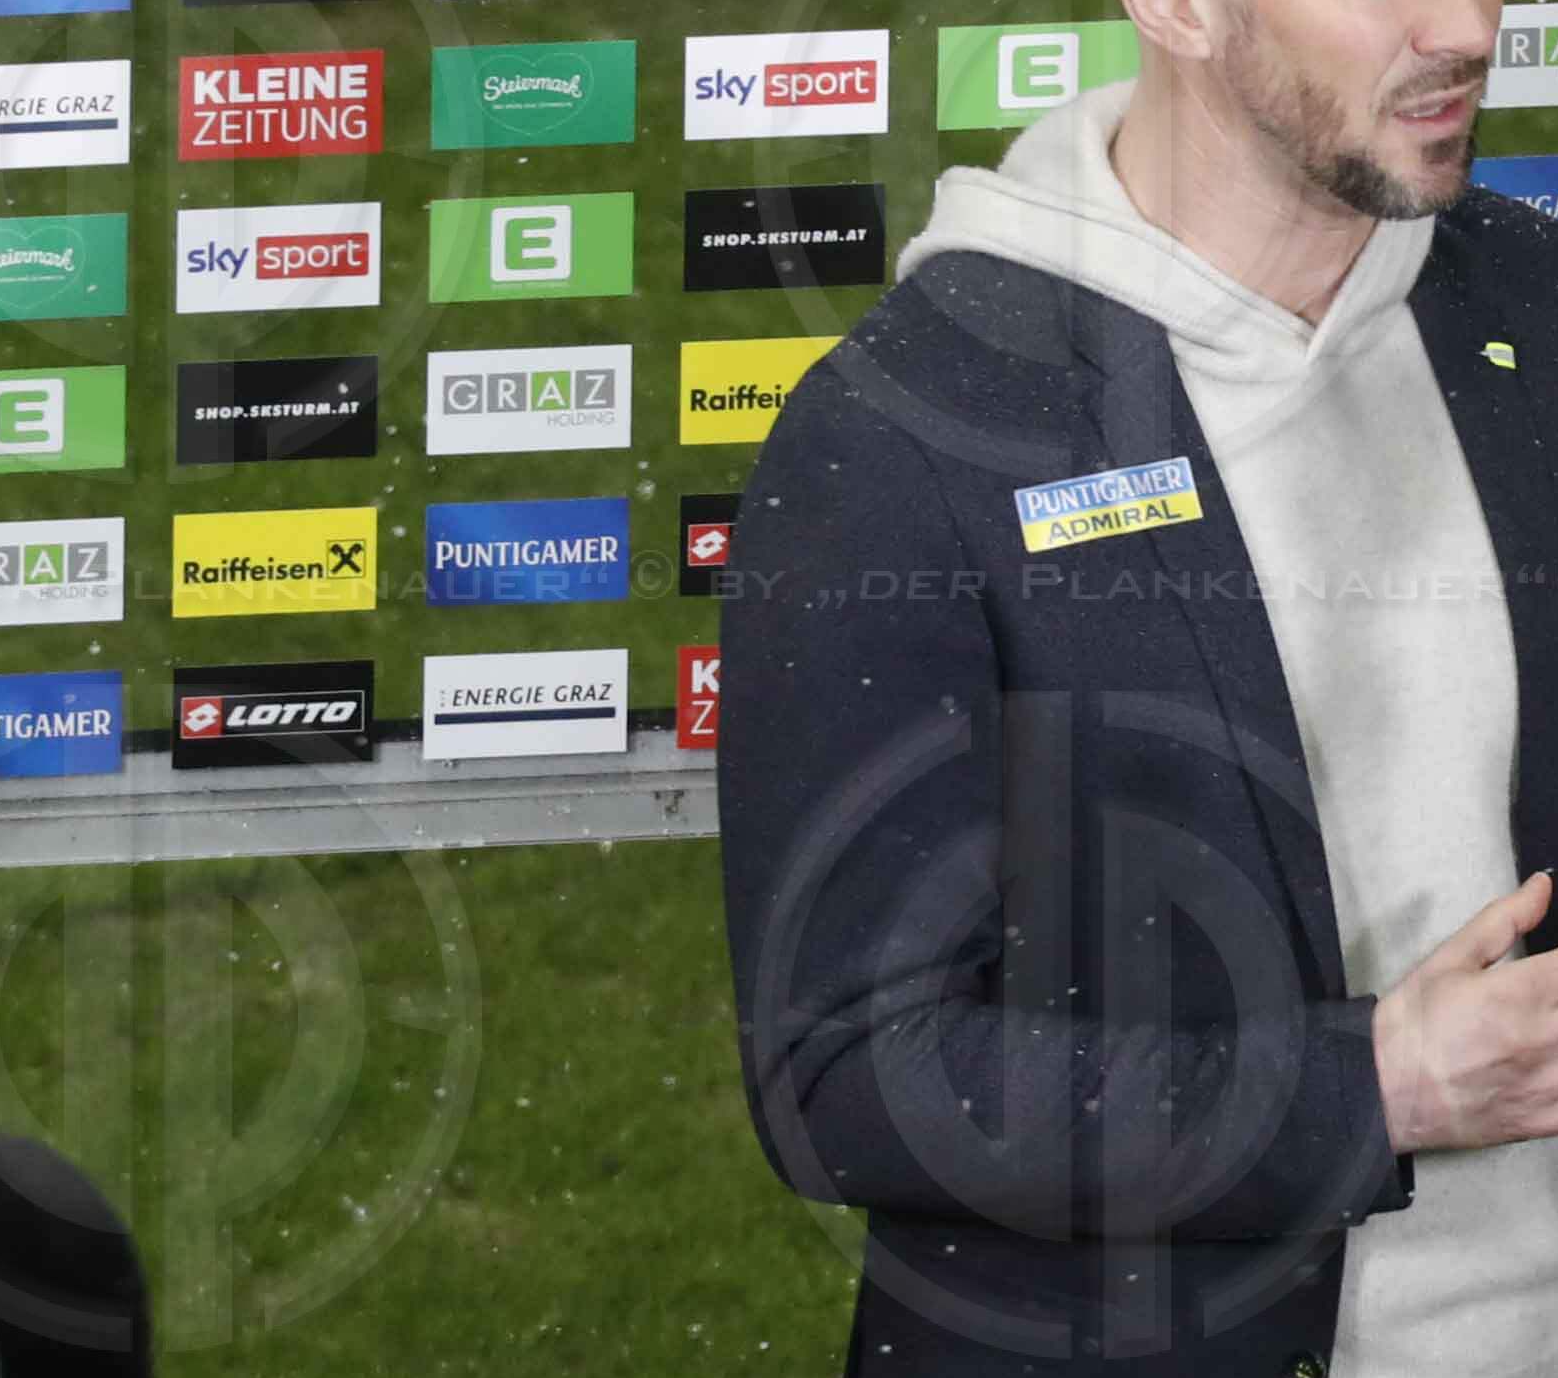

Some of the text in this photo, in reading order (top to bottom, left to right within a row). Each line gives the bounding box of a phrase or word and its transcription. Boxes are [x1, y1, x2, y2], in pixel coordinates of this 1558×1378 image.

[193, 64, 369, 105] KLEINE
[483, 74, 583, 102] Steiermark
[56, 95, 116, 116] GRAZ
[192, 105, 368, 146] ZEITUNG
[702, 228, 868, 247] SHOP.SKSTURM.AT
[186, 239, 362, 279] sky sport
[448, 374, 608, 410] GRAZ
[194, 401, 360, 420] SHOP.SKSTURM.AT
[1024, 462, 1184, 519] PUNTIGAMER
[1048, 498, 1182, 544] ADMIRAL
[451, 683, 613, 708] ENERGIE GRAZ
